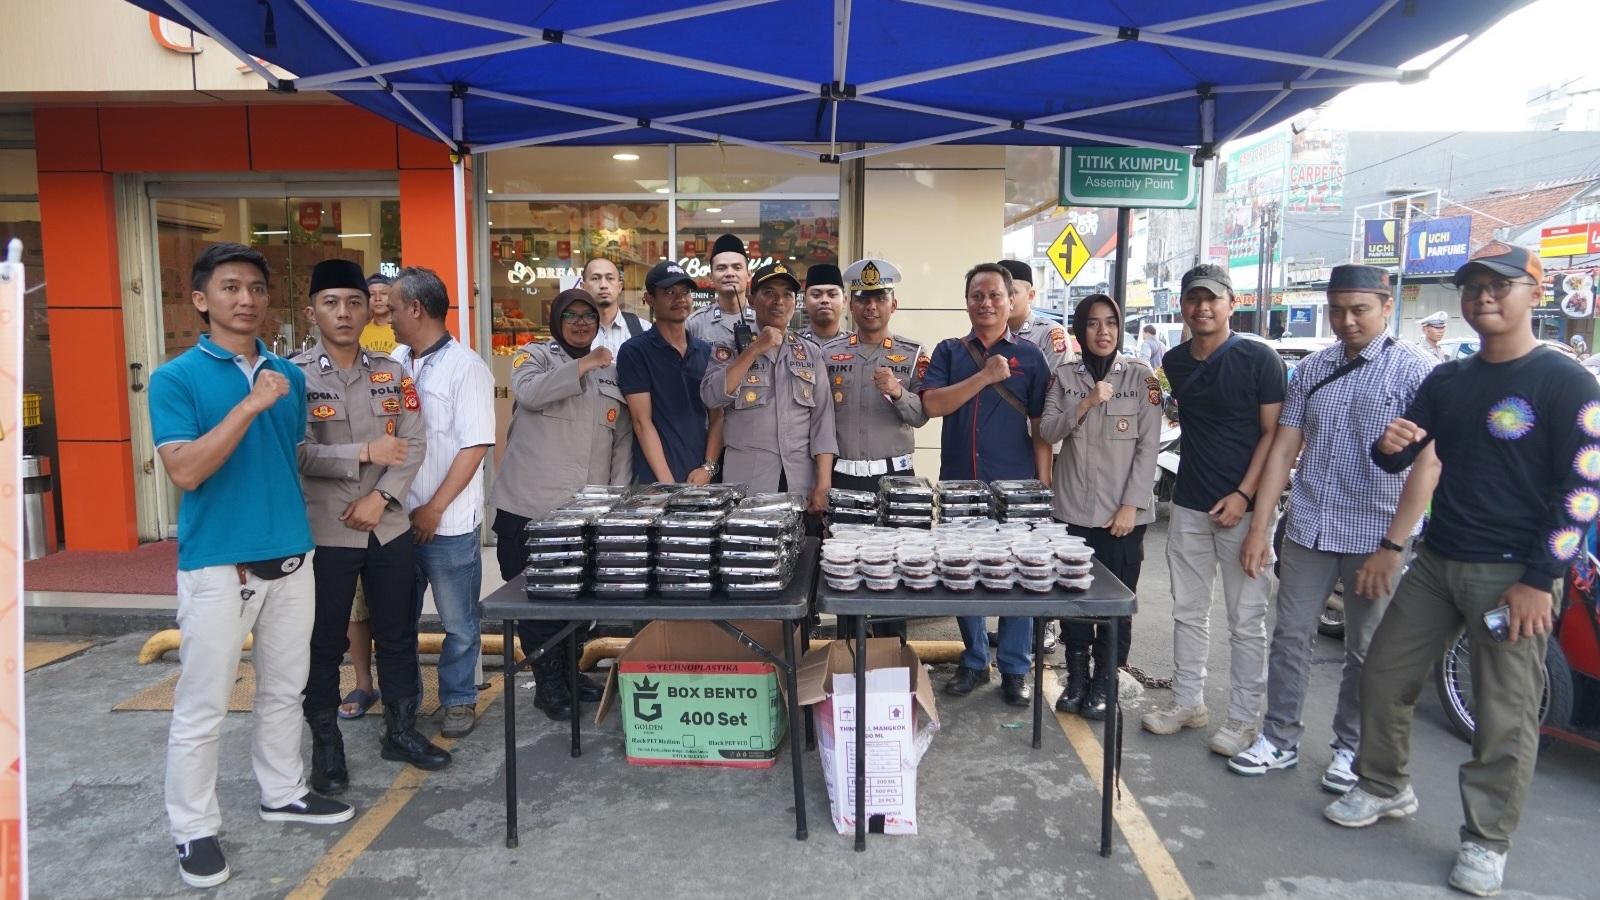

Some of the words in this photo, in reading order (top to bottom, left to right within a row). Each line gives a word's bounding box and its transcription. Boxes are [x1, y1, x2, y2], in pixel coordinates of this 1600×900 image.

[1078, 155, 1115, 169] TITIK
[1119, 157, 1184, 171] KUMPUL
[1085, 176, 1142, 191] Assembly
[1144, 177, 1174, 190] Point
[1427, 232, 1450, 243] UCHI
[1368, 244, 1394, 252] UCHI
[1427, 244, 1467, 257] PARFUME
[660, 664, 738, 672] TECHNOPLASTIKA
[667, 686, 700, 698] BOX
[704, 687, 757, 699] BENTO
[680, 711, 715, 726] 400
[717, 712, 748, 726] Set
